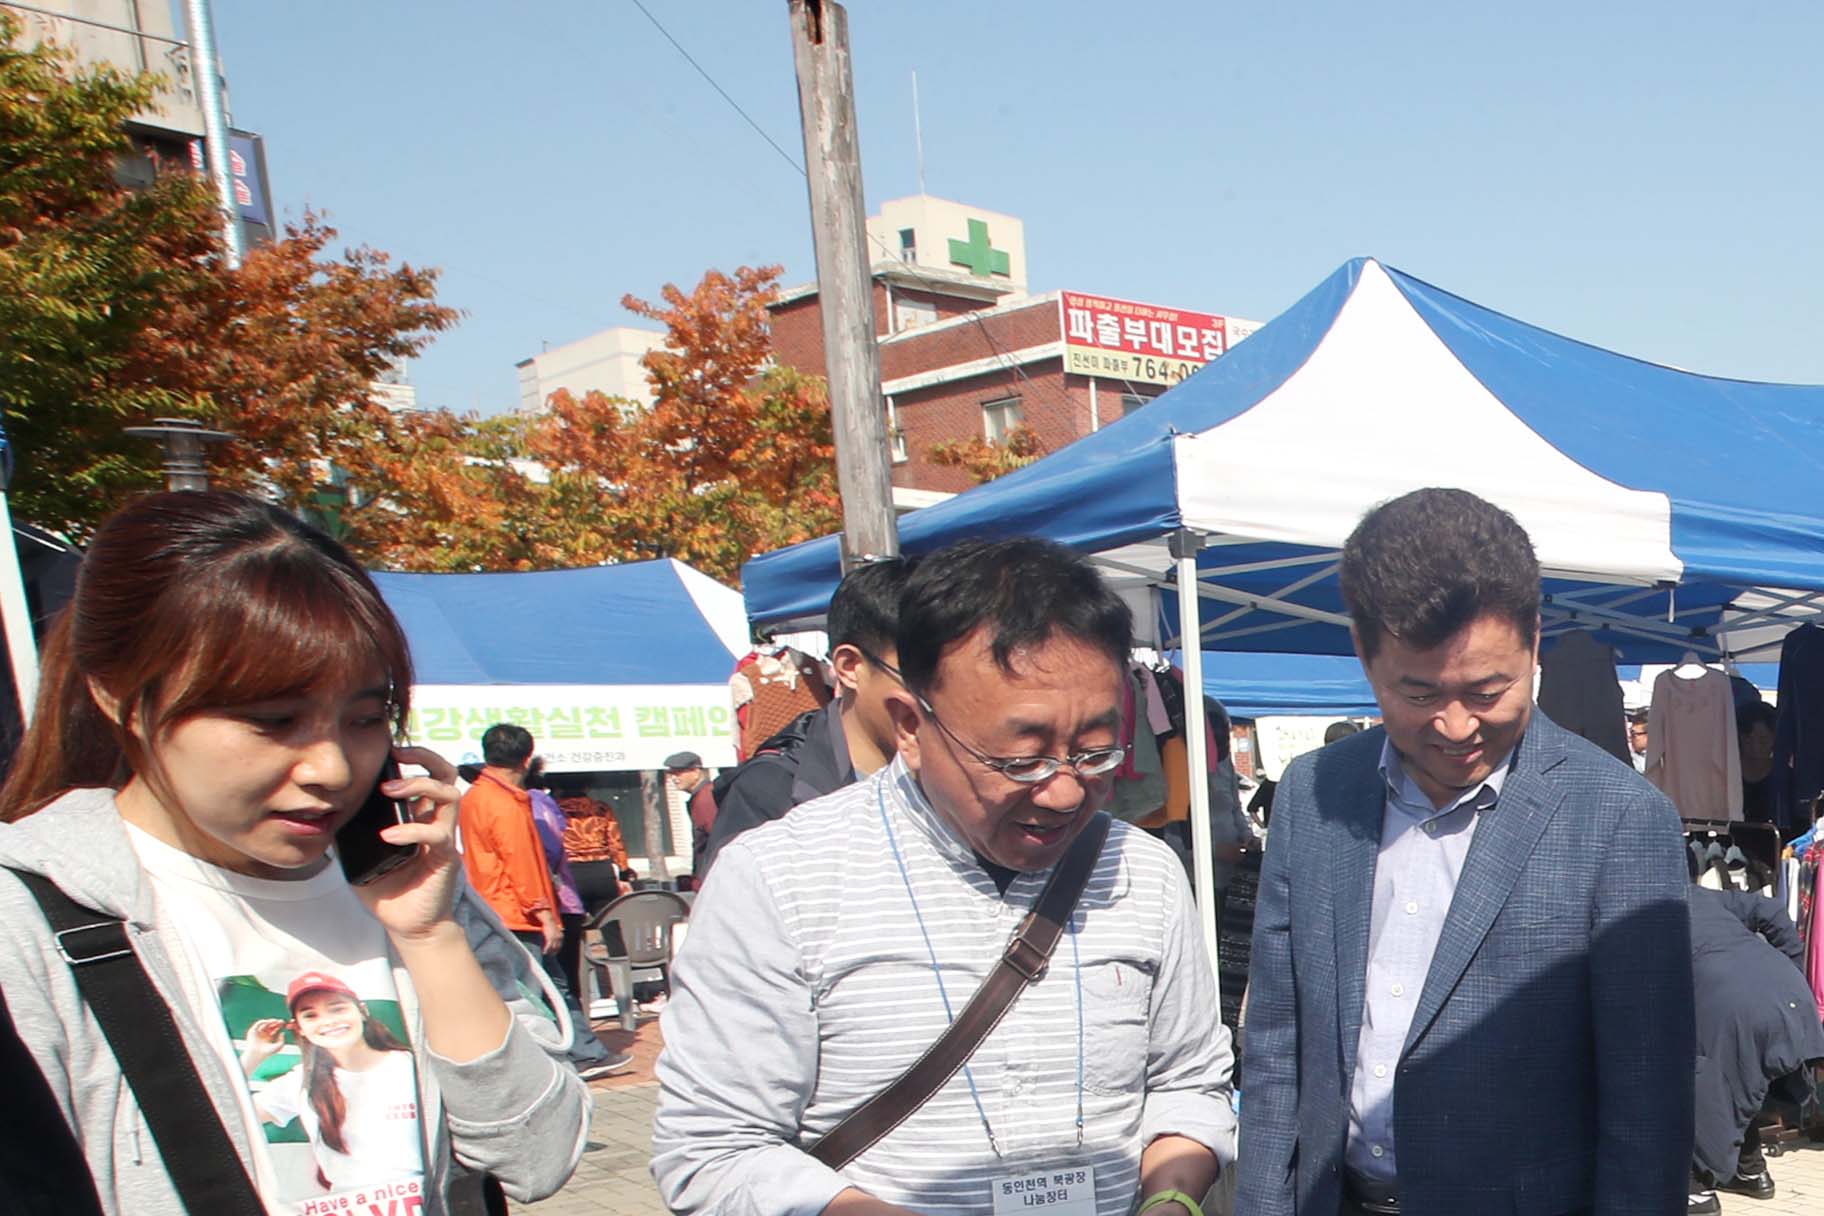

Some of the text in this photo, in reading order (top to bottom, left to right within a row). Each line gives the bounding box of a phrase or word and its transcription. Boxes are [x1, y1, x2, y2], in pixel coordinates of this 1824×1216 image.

[1068, 308, 1223, 360] 파출부대모집
[1103, 357, 1128, 373] 파출부
[1002, 1171, 1086, 1195] 동인천역 북광장
[304, 1182, 419, 1215] Have a nice
[1023, 1189, 1068, 1206] 나눔장터
